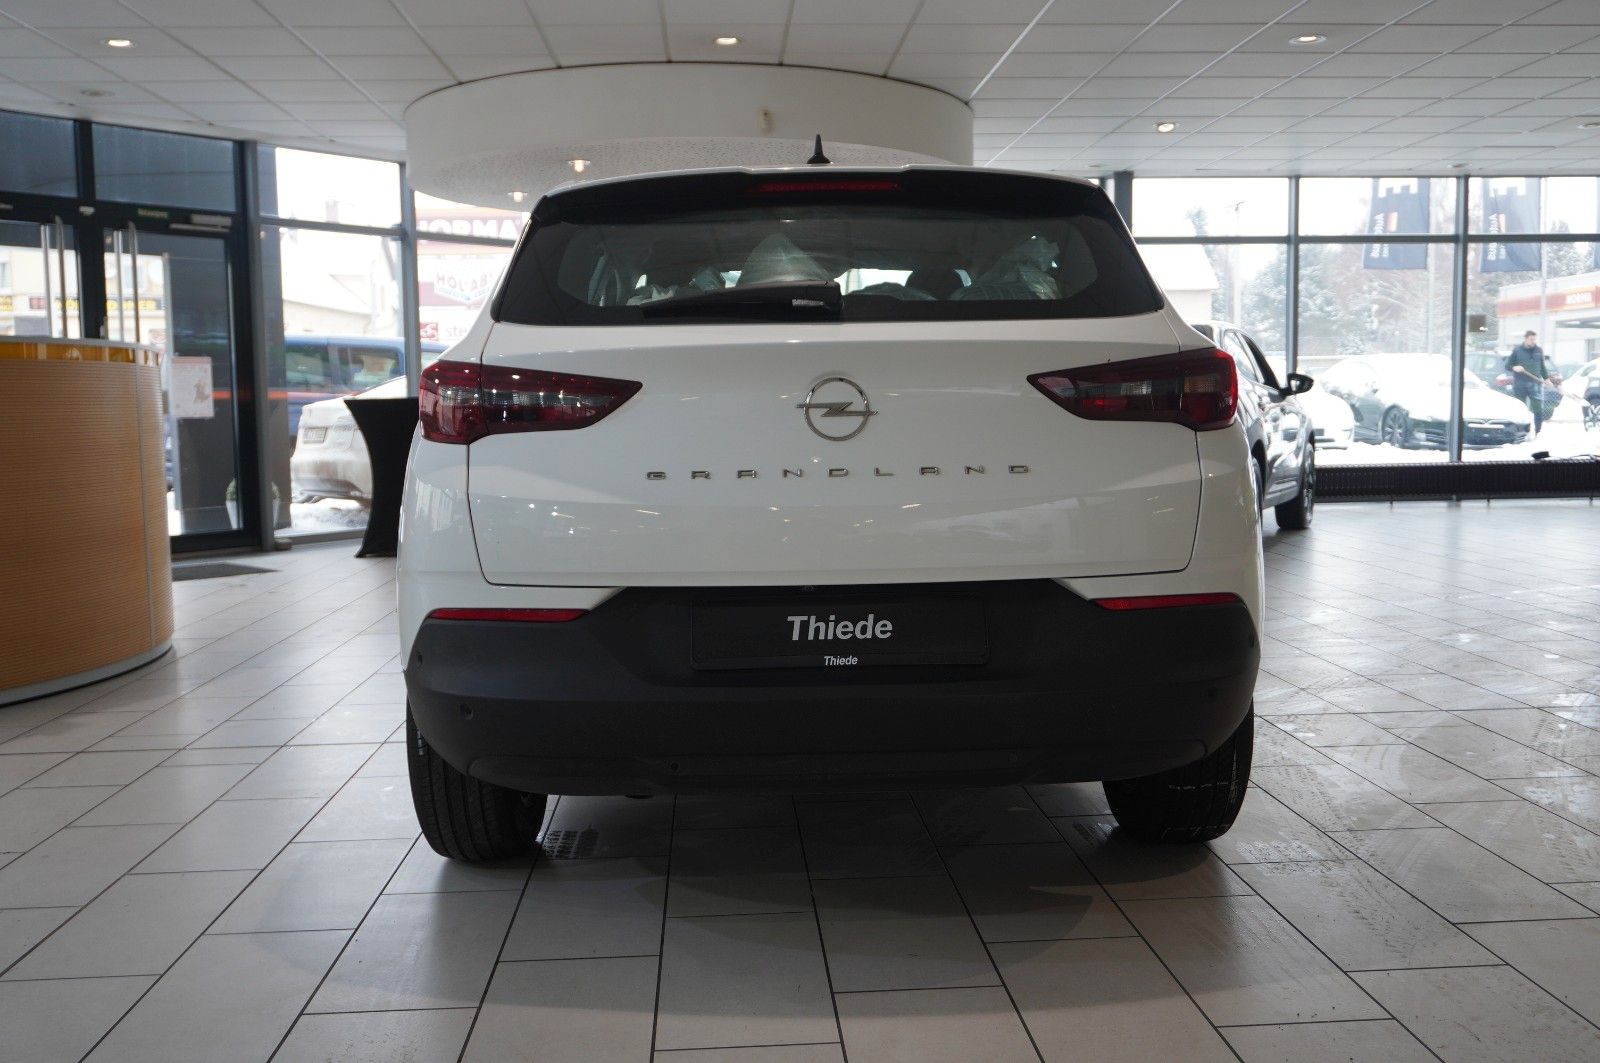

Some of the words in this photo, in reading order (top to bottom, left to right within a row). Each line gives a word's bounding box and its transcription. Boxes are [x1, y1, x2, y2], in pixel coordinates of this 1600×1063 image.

[417, 219, 518, 240] ORMA
[647, 464, 1029, 480] GRANDLAND
[787, 614, 893, 641] Thiede
[824, 655, 858, 666] Thiede
